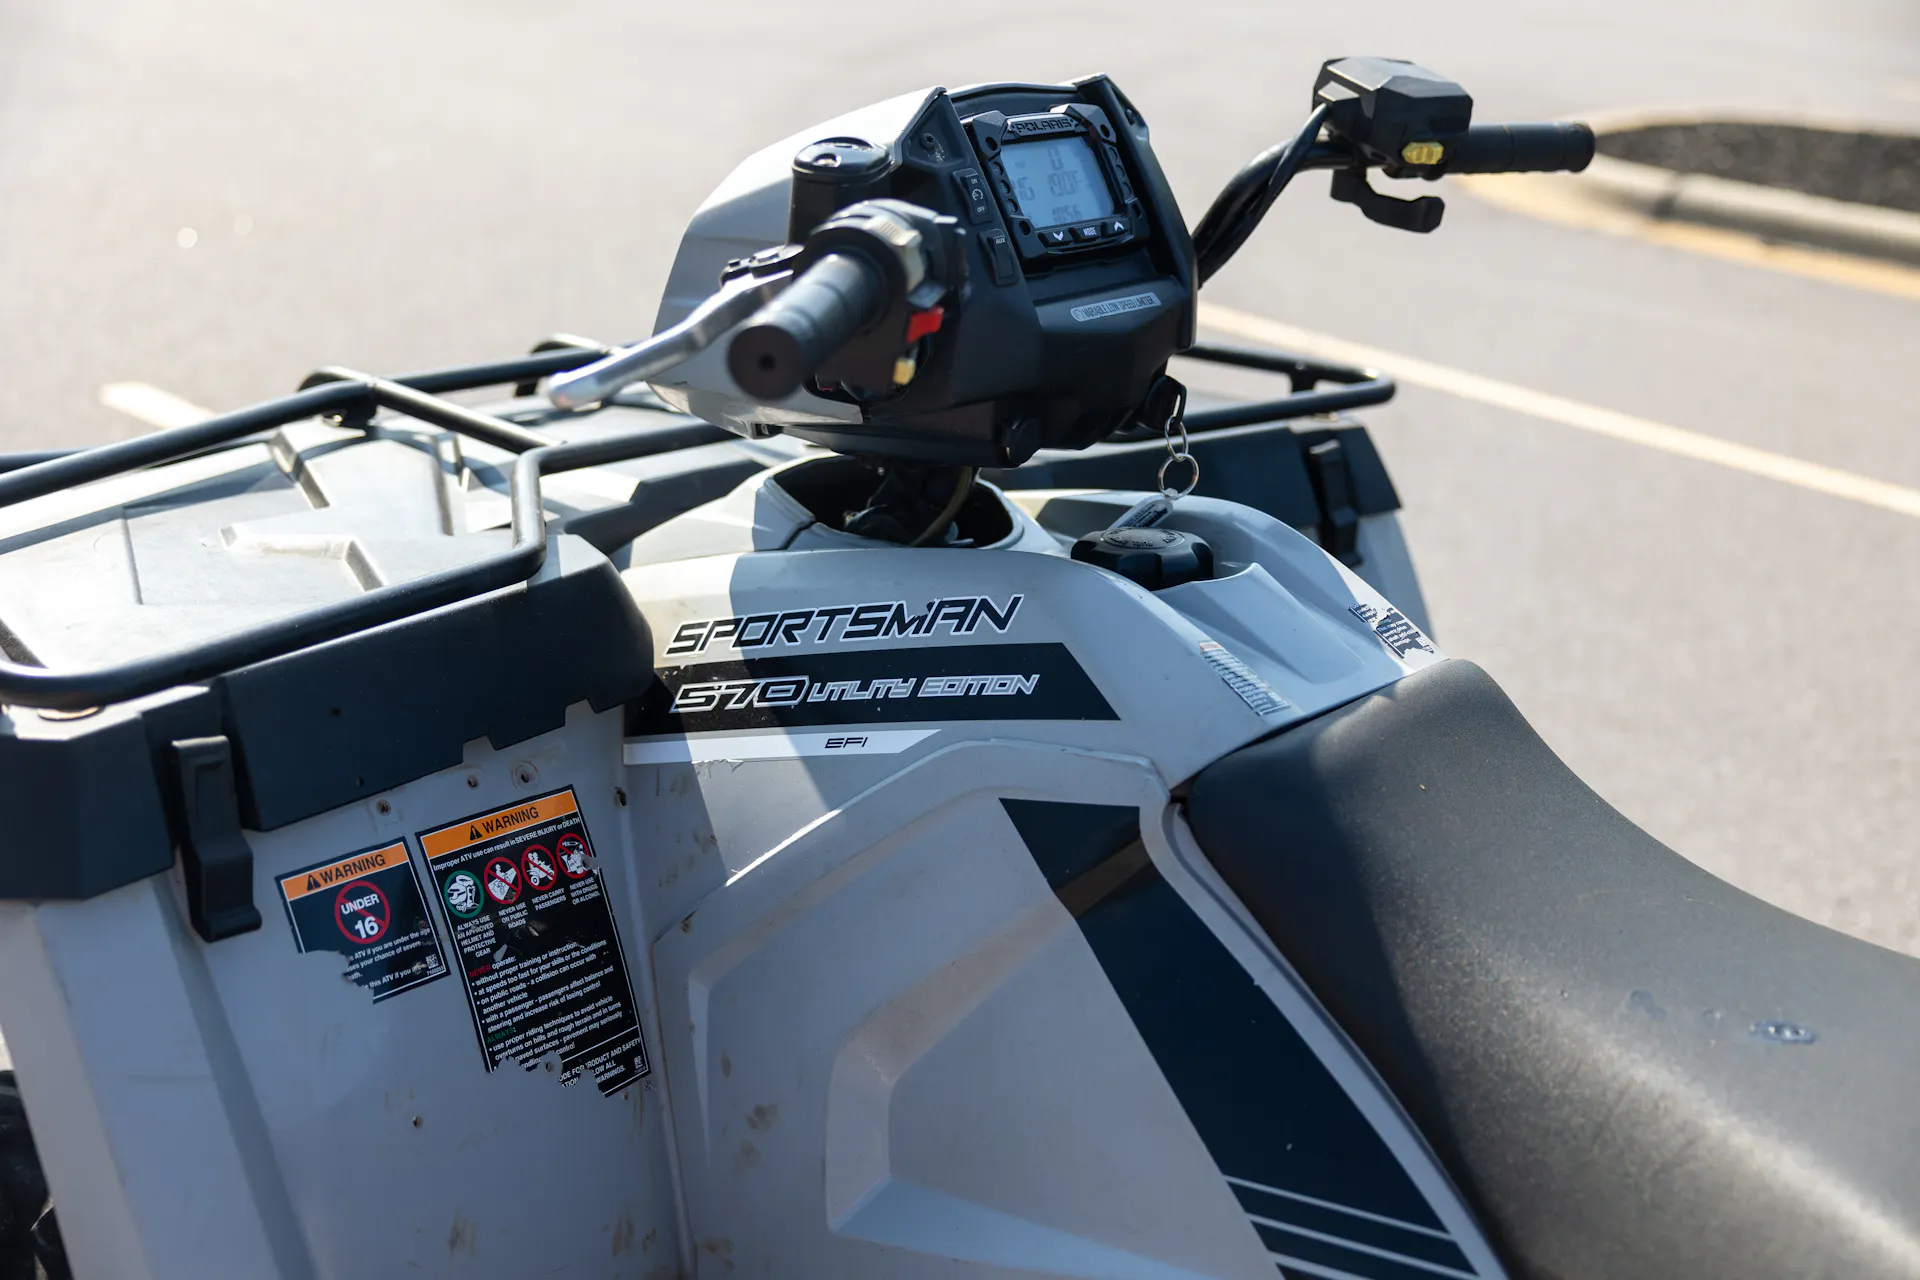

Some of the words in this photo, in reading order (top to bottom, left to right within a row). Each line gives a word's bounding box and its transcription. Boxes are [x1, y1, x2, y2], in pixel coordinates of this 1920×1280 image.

[1015, 118, 1072, 133] POLARIS
[1083, 227, 1097, 236] MODE
[664, 594, 1024, 656] SPORTSMAN
[670, 675, 809, 713] 570
[807, 678, 917, 702] UTILITY
[917, 674, 1040, 698] EDITION
[825, 737, 868, 748] EFI
[482, 806, 540, 834] WARNING
[433, 858, 460, 871] Improper
[460, 852, 472, 862] ATV
[472, 850, 484, 858] use
[494, 841, 510, 851] result
[515, 831, 538, 844] SEVERE
[537, 825, 556, 836] INJURY
[562, 817, 580, 828] DEATH
[319, 854, 386, 883] WARNING
[569, 881, 585, 890] NEVER
[570, 889, 582, 897] WITH
[582, 883, 598, 893] DRUGS
[341, 894, 379, 915] UNDER
[532, 894, 549, 904] NEVER
[548, 888, 564, 898] CARRY
[535, 895, 566, 911] PASSENGERS
[580, 891, 600, 902] ALCOHOL
[498, 906, 516, 916] NEVER
[515, 902, 526, 910] USE
[509, 909, 528, 921] PUBLIC
[354, 916, 379, 940] 16
[457, 919, 479, 931] ALWAYS
[479, 915, 491, 923] USE
[457, 932, 465, 940] AN
[466, 922, 494, 937] APPROVED
[508, 918, 526, 929] ROADS
[355, 950, 366, 959] ATV
[371, 945, 383, 953] you
[383, 941, 393, 949] are
[393, 935, 409, 945] under
[461, 934, 482, 946] HELMET
[483, 930, 494, 939] AND
[464, 937, 496, 954] PROTECTIVE
[360, 958, 373, 967] your
[374, 950, 395, 962] chance
[396, 946, 402, 954] of
[402, 941, 421, 951] severe
[475, 948, 491, 957] GEAR
[469, 964, 491, 977] NEVER
[492, 956, 516, 969] operate:
[475, 972, 499, 986] without
[499, 965, 518, 977] proper
[519, 956, 541, 969] training
[485, 980, 507, 993] speeds
[507, 976, 518, 984] too
[518, 970, 530, 979] fast
[530, 967, 538, 975] for
[538, 962, 551, 971] your
[551, 957, 565, 966] skills
[580, 940, 607, 954] conditions
[369, 980, 381, 988] this
[382, 974, 393, 984] ATV
[399, 969, 411, 977] you
[481, 997, 490, 1005] on
[490, 989, 509, 1001] public
[509, 982, 527, 993] roads
[535, 969, 559, 983] collision
[559, 965, 570, 973] can
[570, 958, 585, 969] occur
[584, 953, 596, 962] with
[483, 1001, 506, 1014] another
[506, 992, 528, 1004] vehicle
[485, 1013, 499, 1023] with
[504, 999, 534, 1016] passenger
[538, 985, 569, 1002] passengers
[570, 978, 585, 989] affect
[584, 970, 604, 982] balance
[604, 965, 614, 974] and
[488, 1019, 512, 1033] steering
[512, 1012, 524, 1023] and
[524, 1004, 548, 1018] increase
[548, 998, 560, 1008] risk
[560, 995, 566, 1003] of
[566, 990, 583, 1000] losing
[583, 980, 601, 993] control
[493, 1042, 505, 1051] use
[505, 1033, 525, 1047] proper
[526, 1026, 544, 1037] riding
[543, 1013, 574, 1029] techniques
[580, 1003, 595, 1014] avoid
[595, 996, 613, 1007] vehicle
[495, 1044, 524, 1060] overturns
[524, 1040, 533, 1048] on
[533, 1035, 546, 1044] hills
[547, 1028, 558, 1038] and
[558, 1022, 575, 1033] rough
[574, 1015, 592, 1027] terrain
[592, 1009, 602, 1019] and
[608, 1002, 621, 1011] turns
[534, 1039, 559, 1054] surfaces
[563, 1026, 588, 1042] pavement
[588, 1021, 600, 1031] may
[600, 1011, 622, 1025] seriously
[609, 1046, 622, 1057] AND
[621, 1037, 641, 1051] SAFETY
[604, 1059, 616, 1069] ALL
